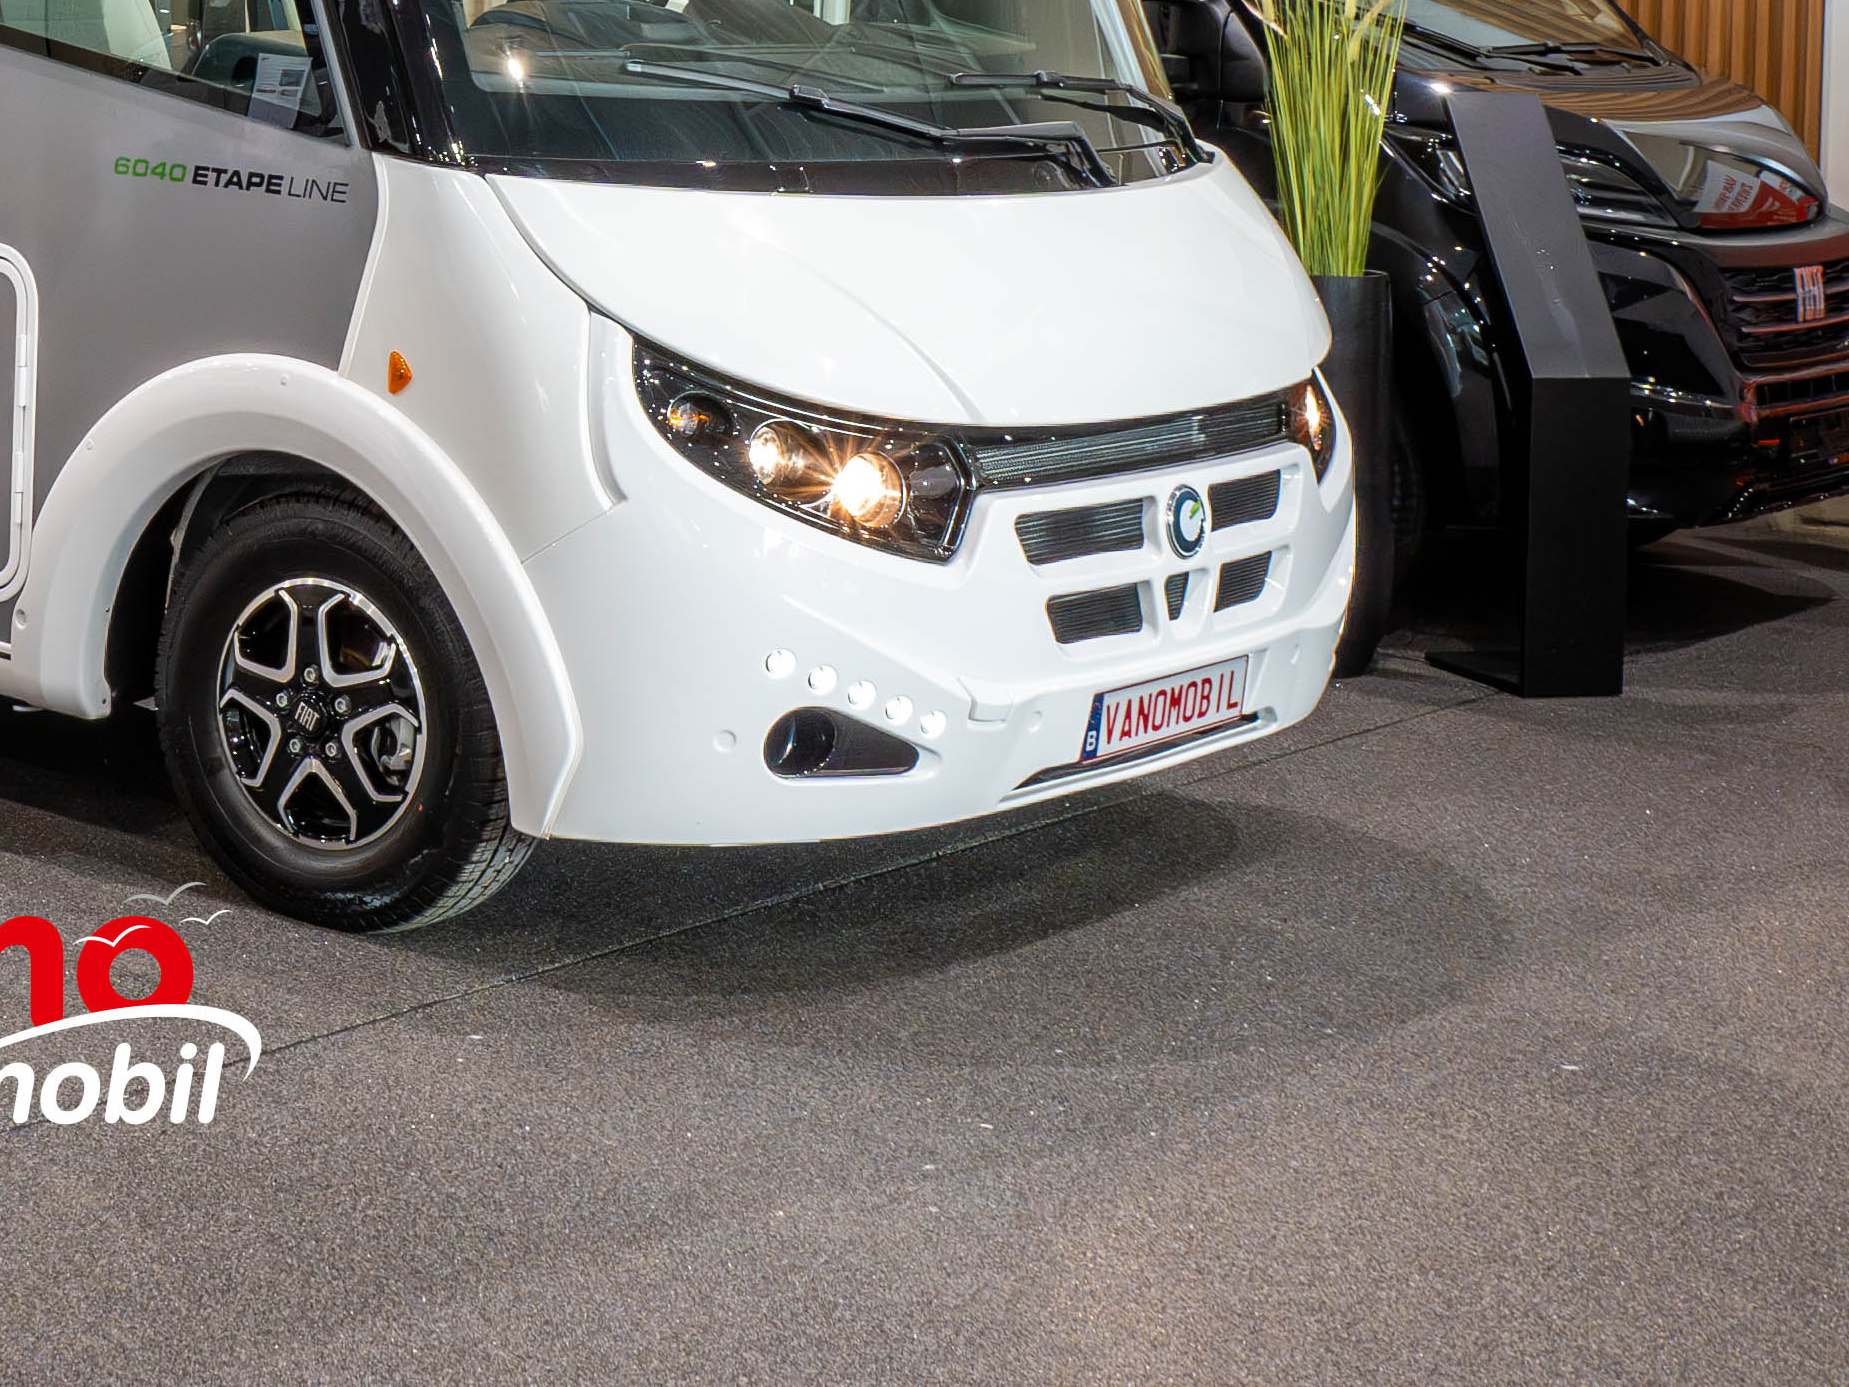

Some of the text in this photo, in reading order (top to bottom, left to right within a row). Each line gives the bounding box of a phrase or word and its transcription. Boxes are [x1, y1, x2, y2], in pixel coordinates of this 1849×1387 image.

[114, 156, 188, 183] 6040
[294, 701, 320, 731] FIAT
[1085, 669, 1239, 752] B VANOMOBIL
